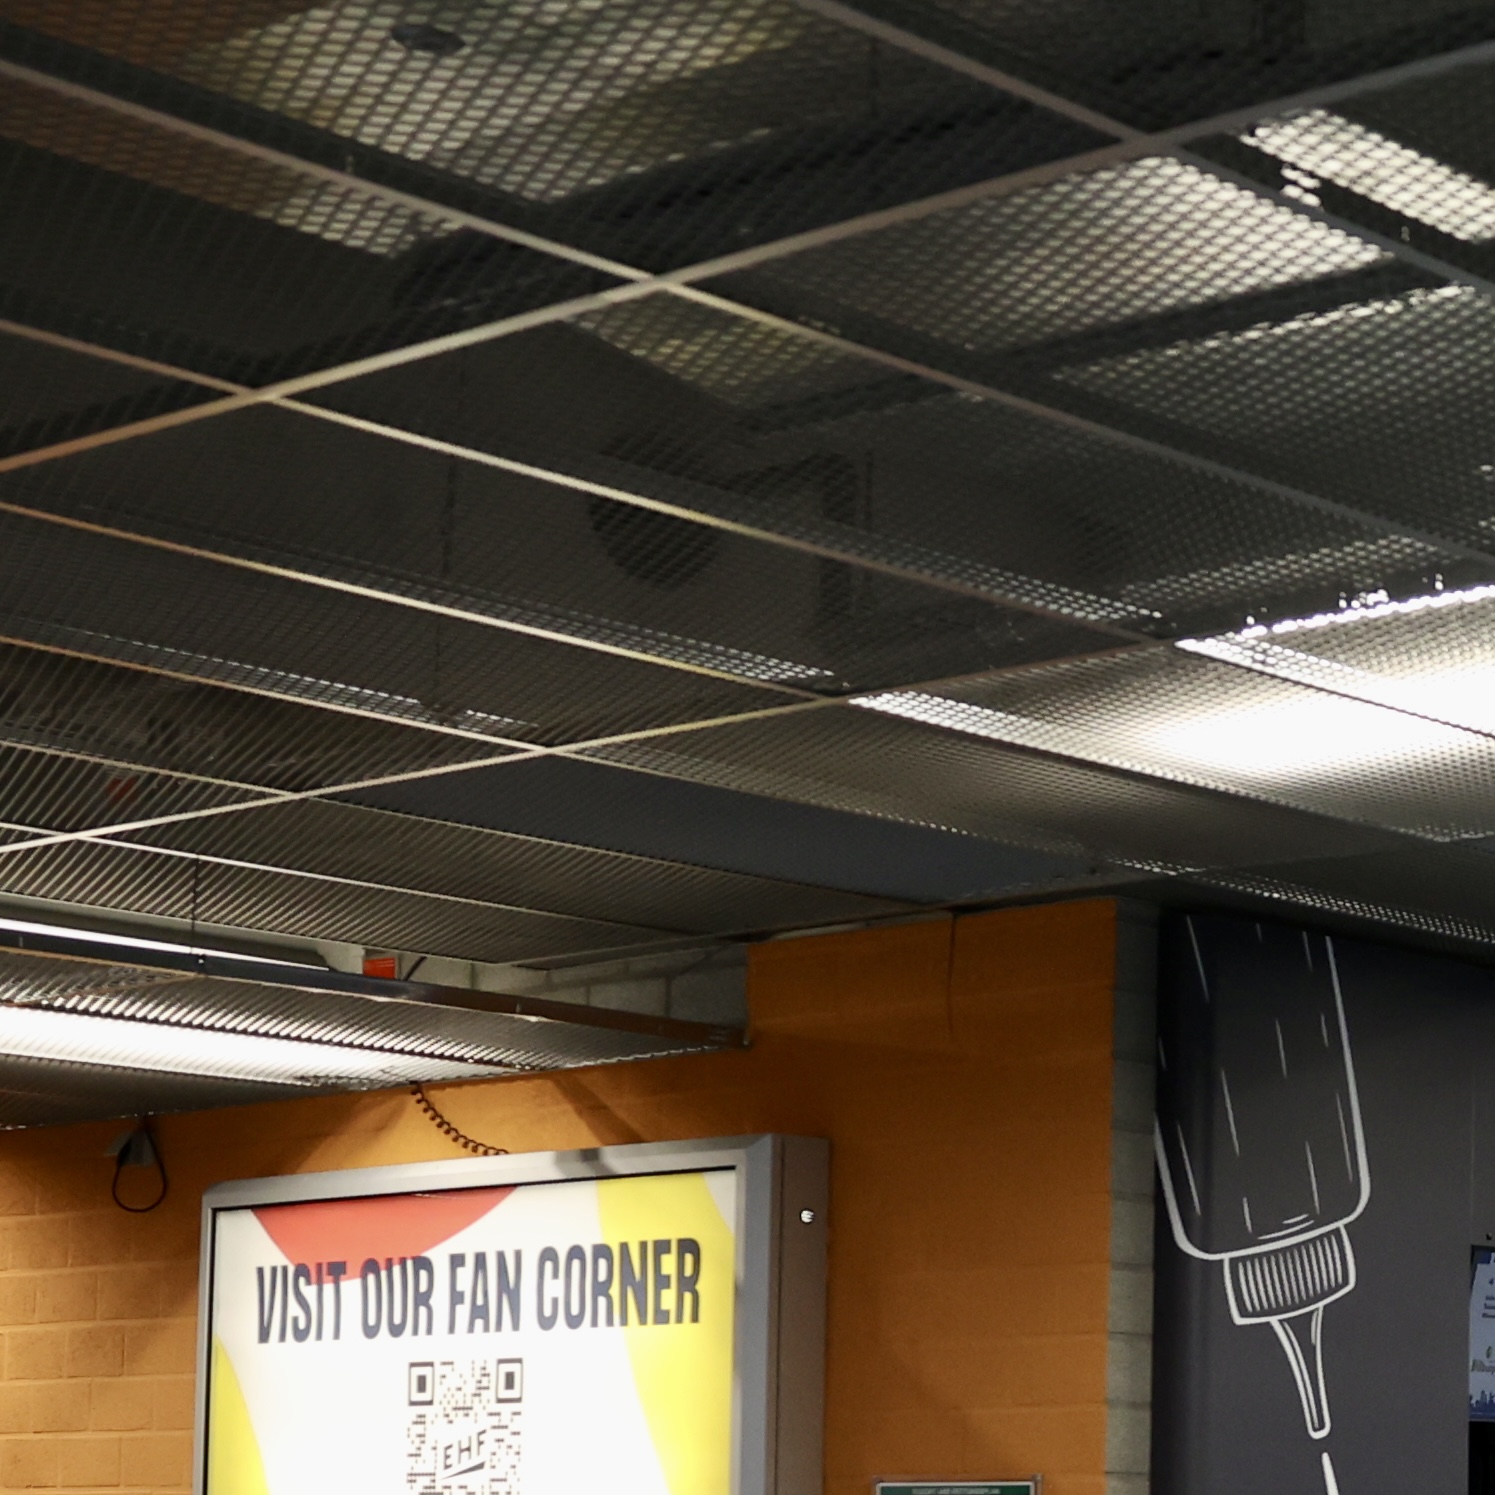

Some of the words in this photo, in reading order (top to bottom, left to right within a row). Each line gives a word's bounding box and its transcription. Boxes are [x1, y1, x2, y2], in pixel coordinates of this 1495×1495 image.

[255, 1261, 347, 1344] VISIT
[360, 1255, 435, 1340] OUR
[448, 1249, 523, 1335] FAN
[537, 1237, 701, 1331] CORNER
[444, 1429, 487, 1470] EHF
